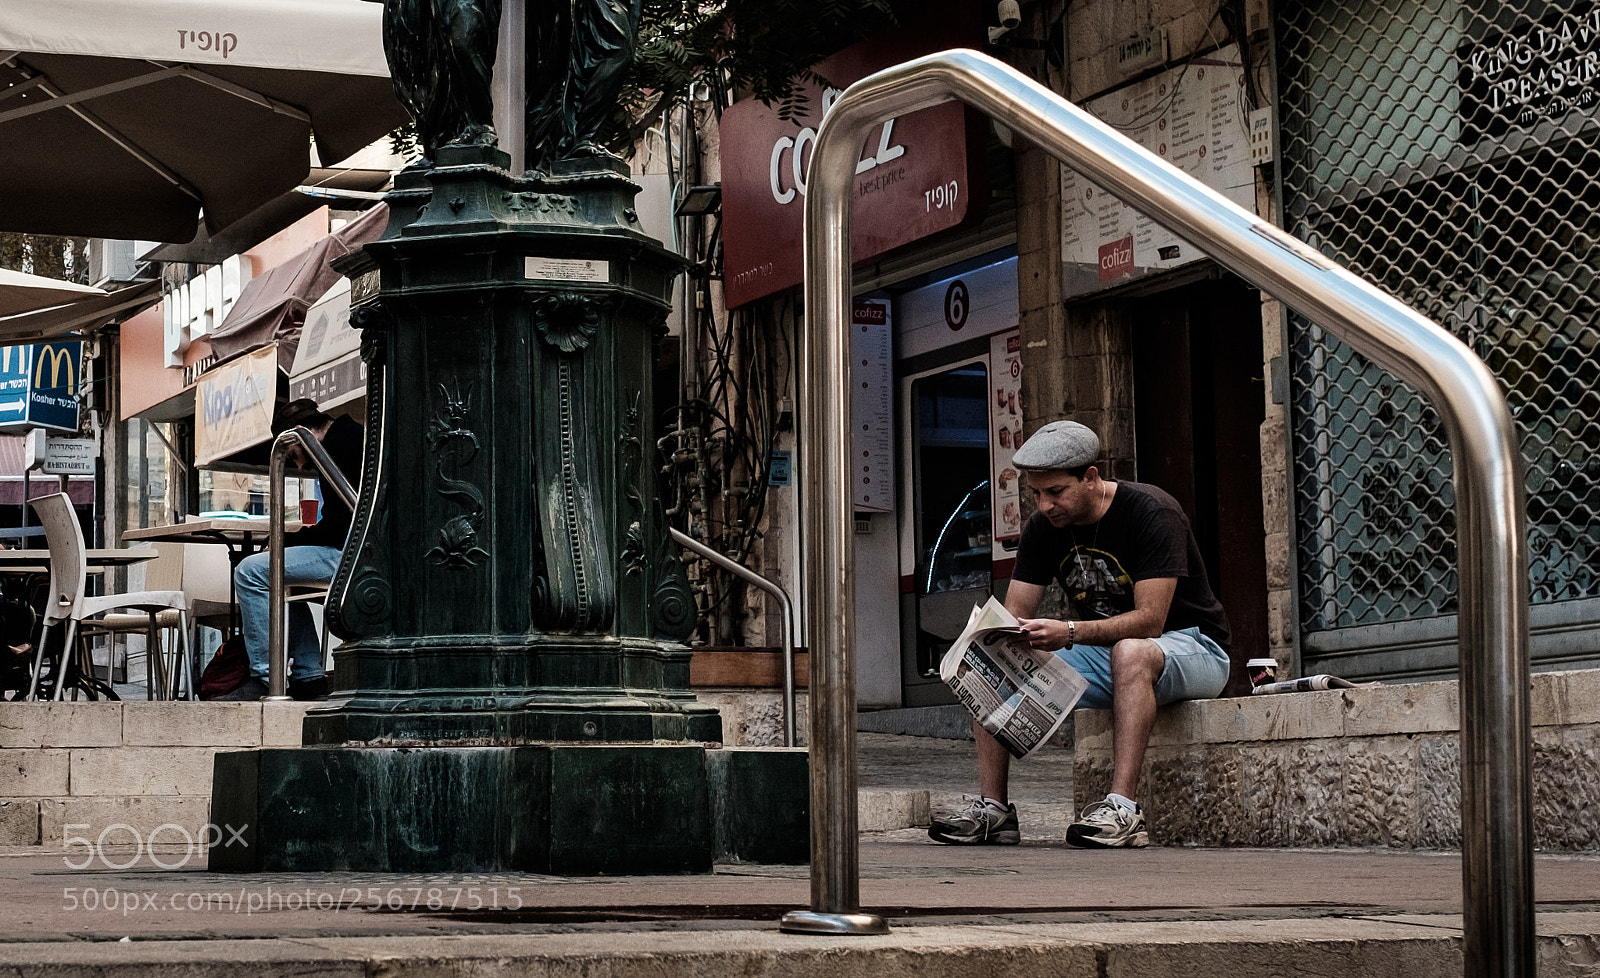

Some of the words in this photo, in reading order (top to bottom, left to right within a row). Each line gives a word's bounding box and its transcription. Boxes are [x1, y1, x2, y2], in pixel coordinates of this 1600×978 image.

[176, 29, 238, 59] קופיז
[859, 176, 881, 196] best
[881, 168, 906, 192] price
[924, 179, 959, 213] קופיז
[1101, 248, 1131, 270] cofizz
[854, 307, 884, 320] cofizz
[949, 286, 966, 326] 6
[31, 391, 56, 406] Kosher
